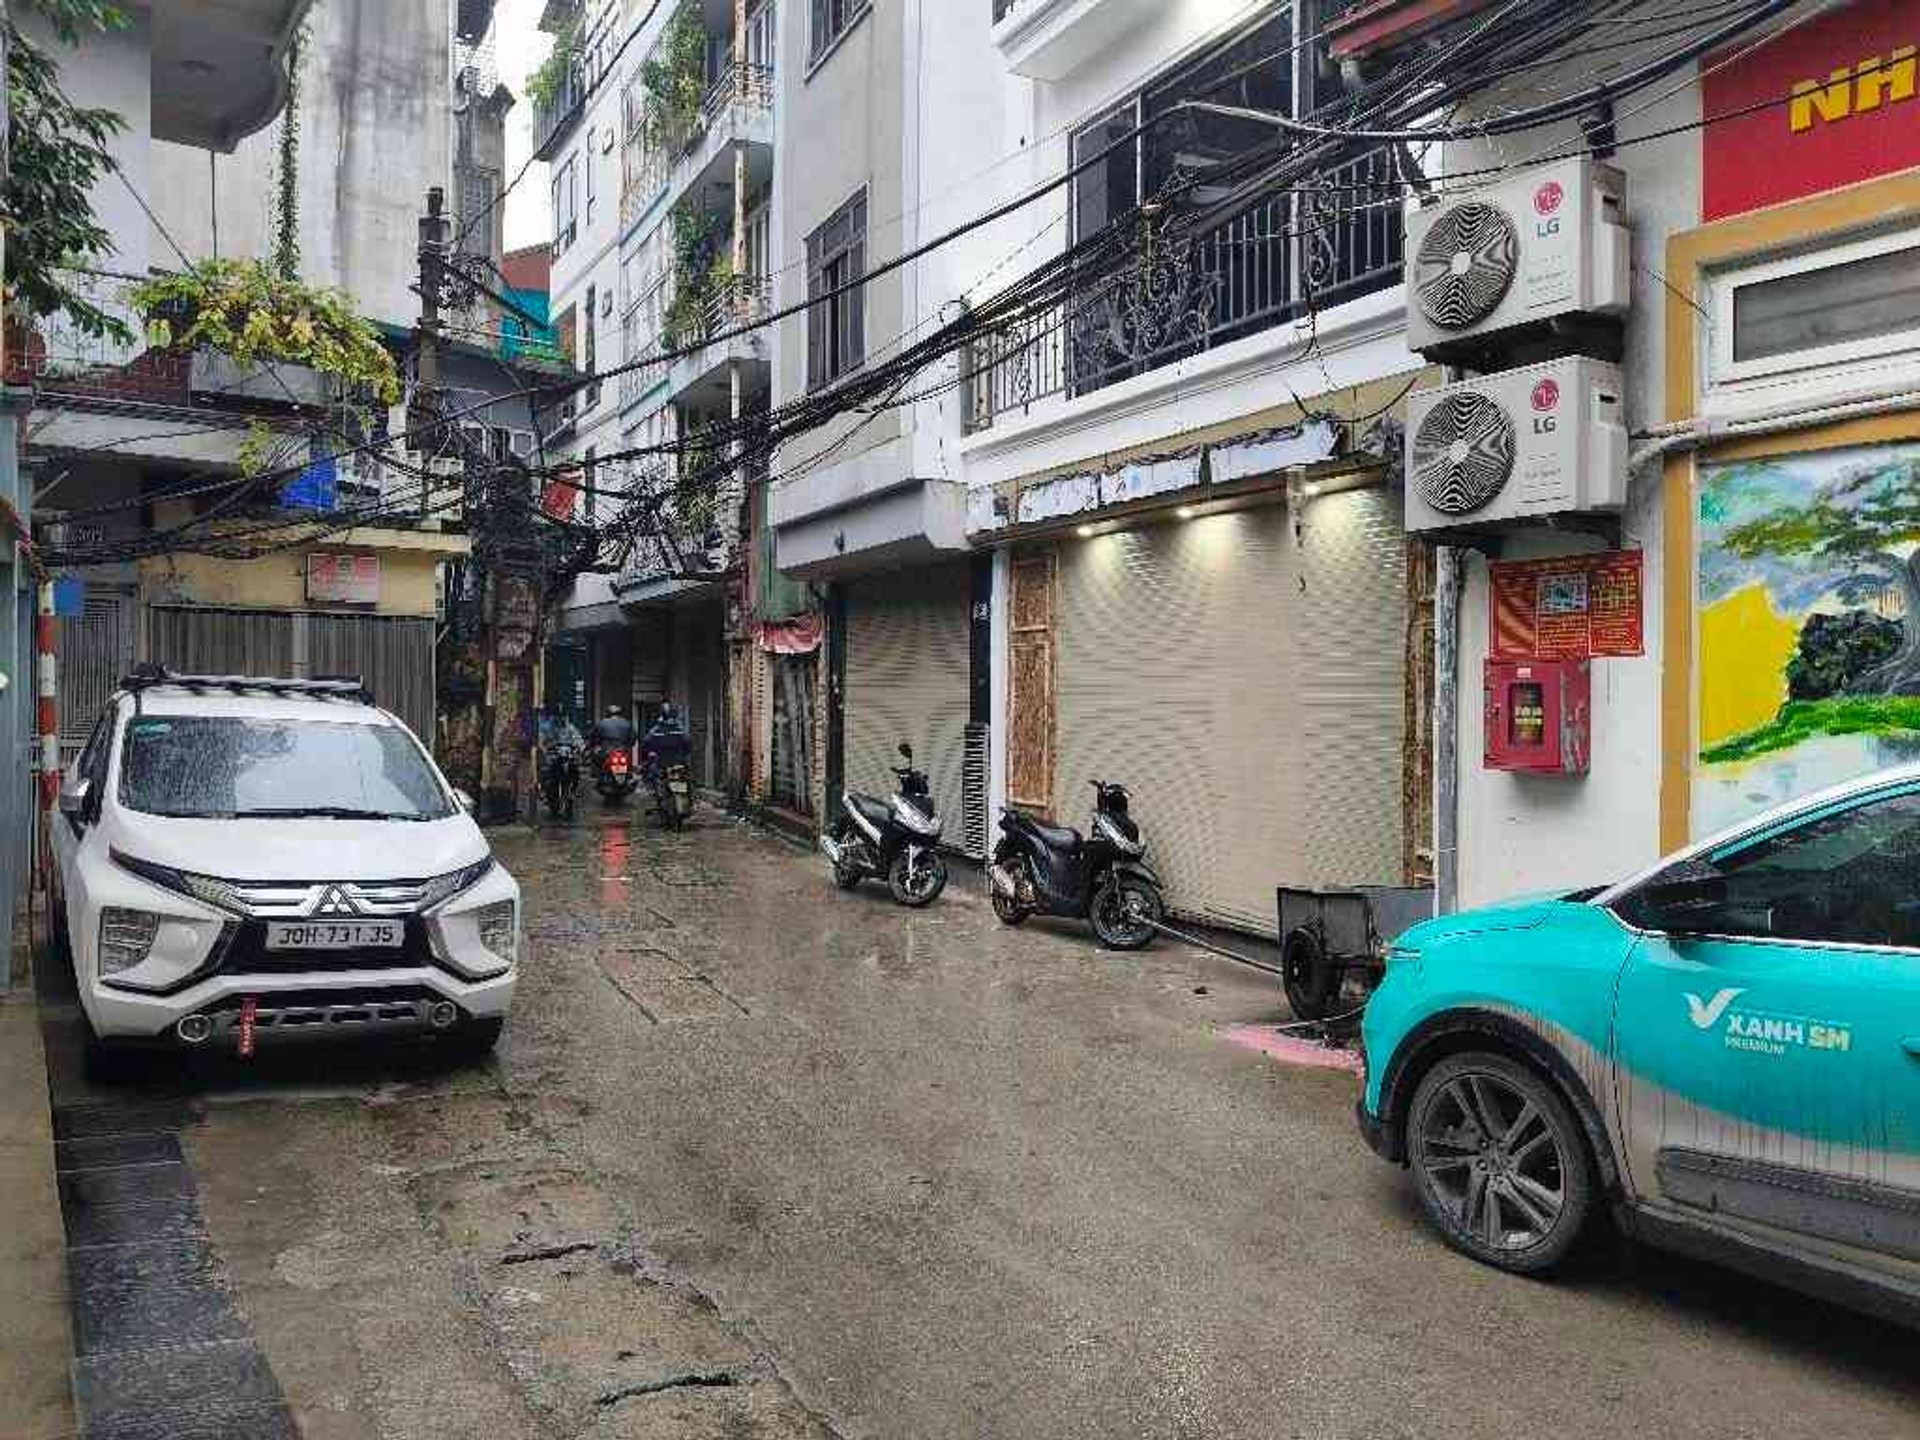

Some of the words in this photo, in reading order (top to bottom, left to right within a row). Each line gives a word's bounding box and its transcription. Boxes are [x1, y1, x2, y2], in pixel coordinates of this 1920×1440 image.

[1537, 218, 1560, 237] LG
[1533, 416, 1556, 434] LG
[1726, 1014, 1804, 1045] XANH
[1808, 1025, 1850, 1051] SM
[1725, 1035, 1785, 1055] PREMIUM
